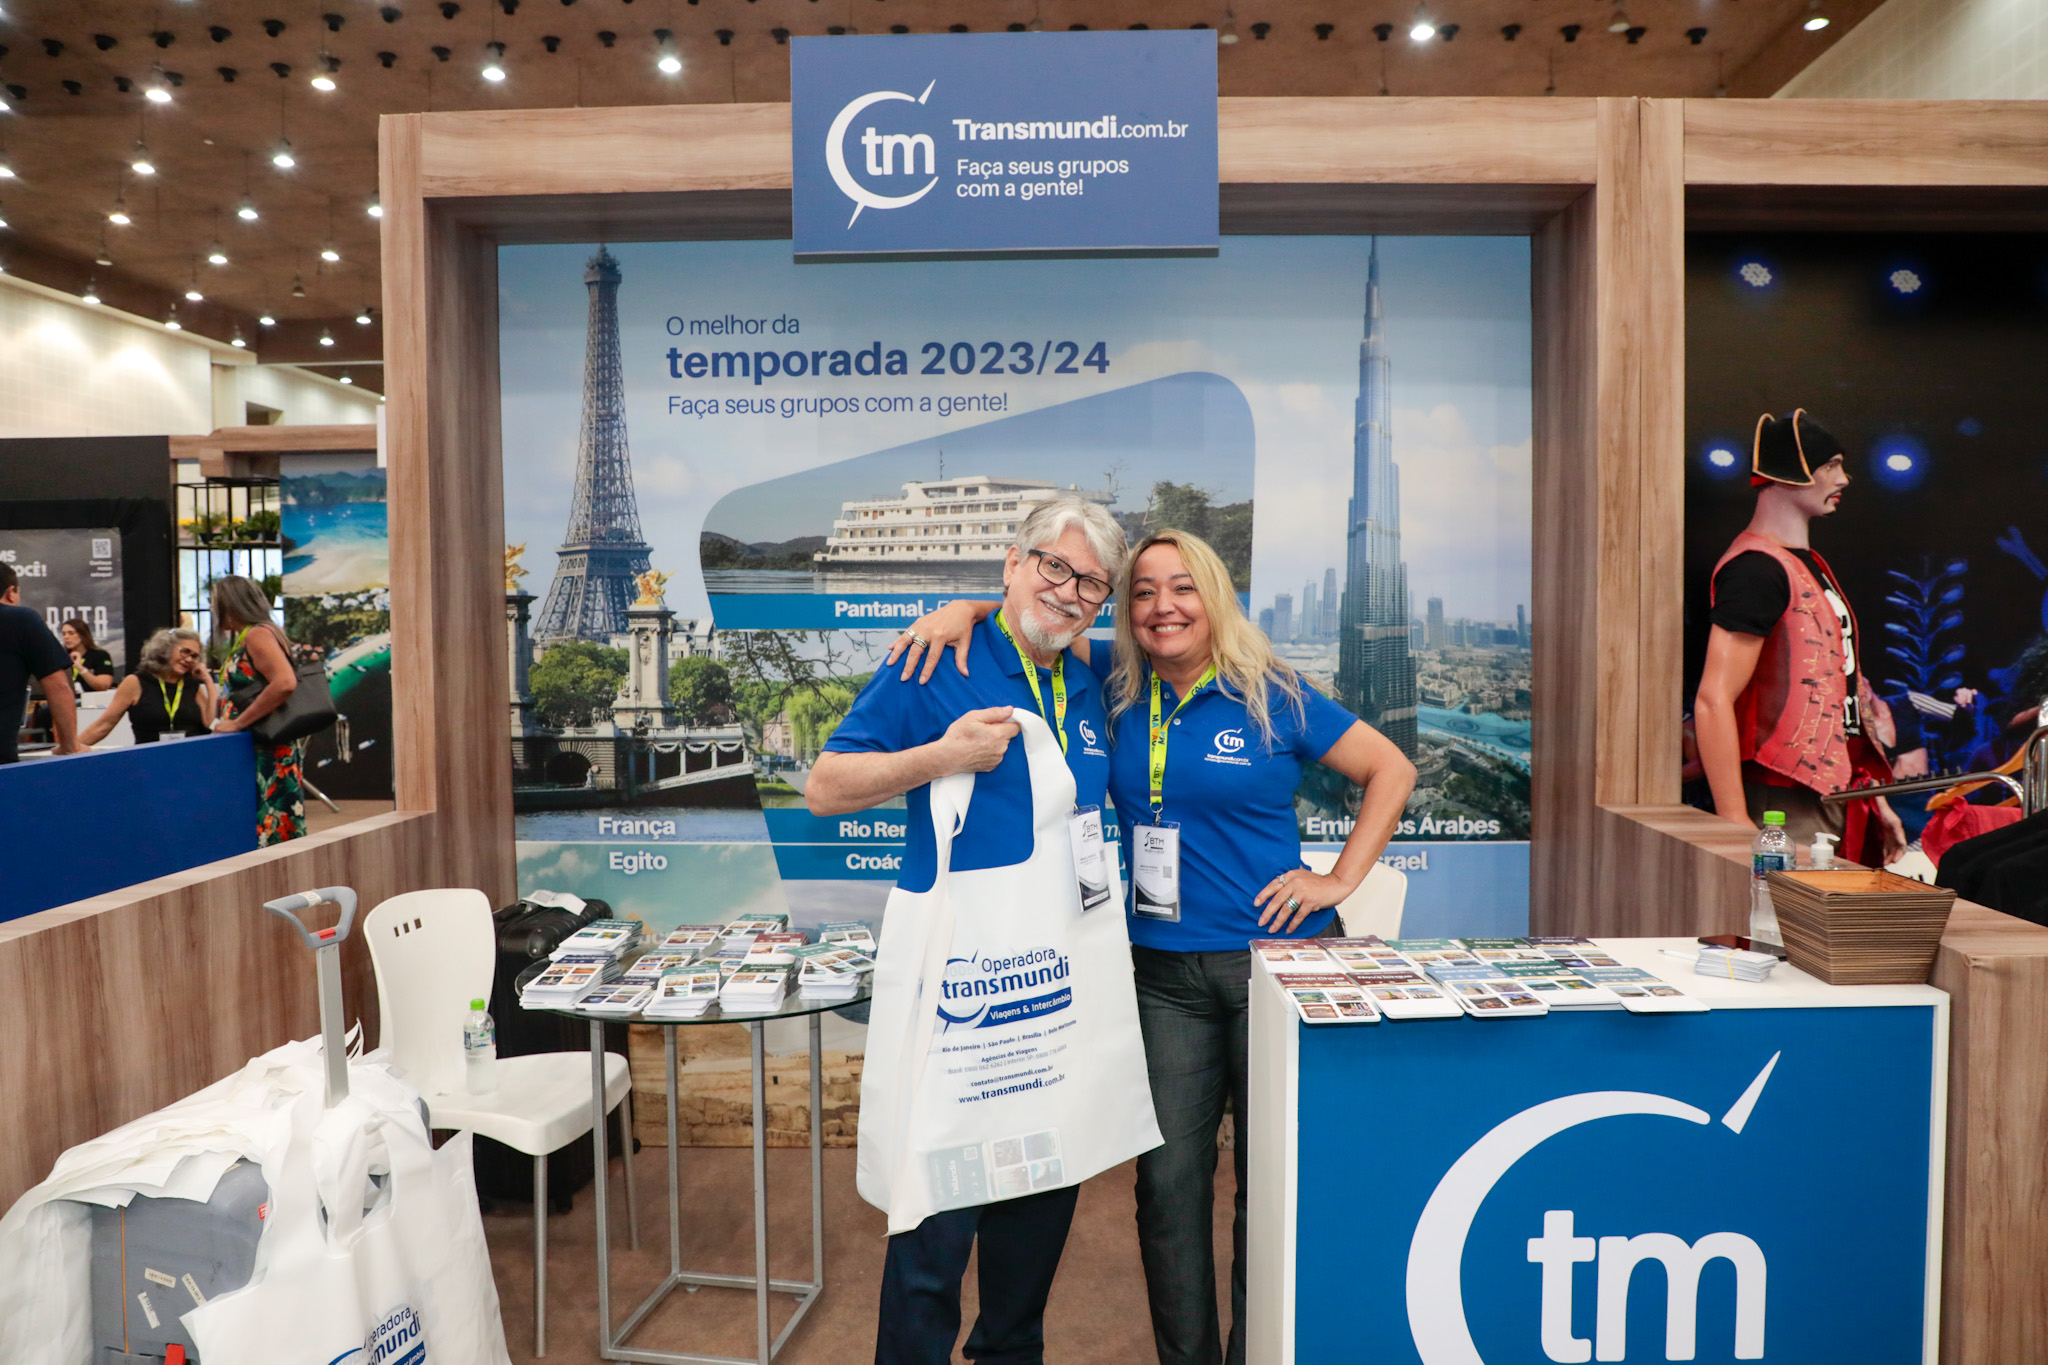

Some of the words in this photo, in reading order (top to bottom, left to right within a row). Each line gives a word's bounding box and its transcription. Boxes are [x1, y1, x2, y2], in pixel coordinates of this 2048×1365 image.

[952, 115, 1188, 141] Transmundi.com.br
[861, 127, 935, 175] tm
[957, 158, 1004, 180] Faça
[1008, 161, 1053, 175] seus
[1059, 157, 1129, 178] grupos
[956, 182, 999, 197] com
[1004, 182, 1016, 196] a
[1020, 179, 1084, 200] gente!
[666, 316, 684, 335] O
[690, 314, 767, 335] melhor
[772, 314, 800, 334] da
[666, 341, 908, 385] temporada
[920, 341, 1110, 375] 2023/24
[668, 396, 720, 418] Faça
[725, 398, 775, 415] seus
[780, 396, 860, 418] grupos
[864, 395, 914, 413] com
[919, 397, 932, 412] a
[937, 392, 1008, 416] gente!
[835, 600, 924, 617] Pantanal
[1223, 734, 1244, 748] tm
[599, 816, 676, 840] França
[839, 820, 871, 838] Rio
[1306, 815, 1416, 835] Emios
[1418, 813, 1500, 835] Árabes
[609, 850, 668, 875] Egito
[1377, 850, 1428, 870] rael
[982, 949, 1056, 975] Operadora
[942, 956, 1069, 999] transmundi
[990, 1007, 1021, 1020] Viagens
[1023, 1005, 1030, 1013] &
[1031, 993, 1071, 1011] Intercâmbio
[960, 1044, 980, 1052] Janeiro
[959, 1073, 1065, 1103] www.transmundi.com.br
[1527, 1209, 1767, 1363] tm
[368, 1307, 411, 1348] eradora
